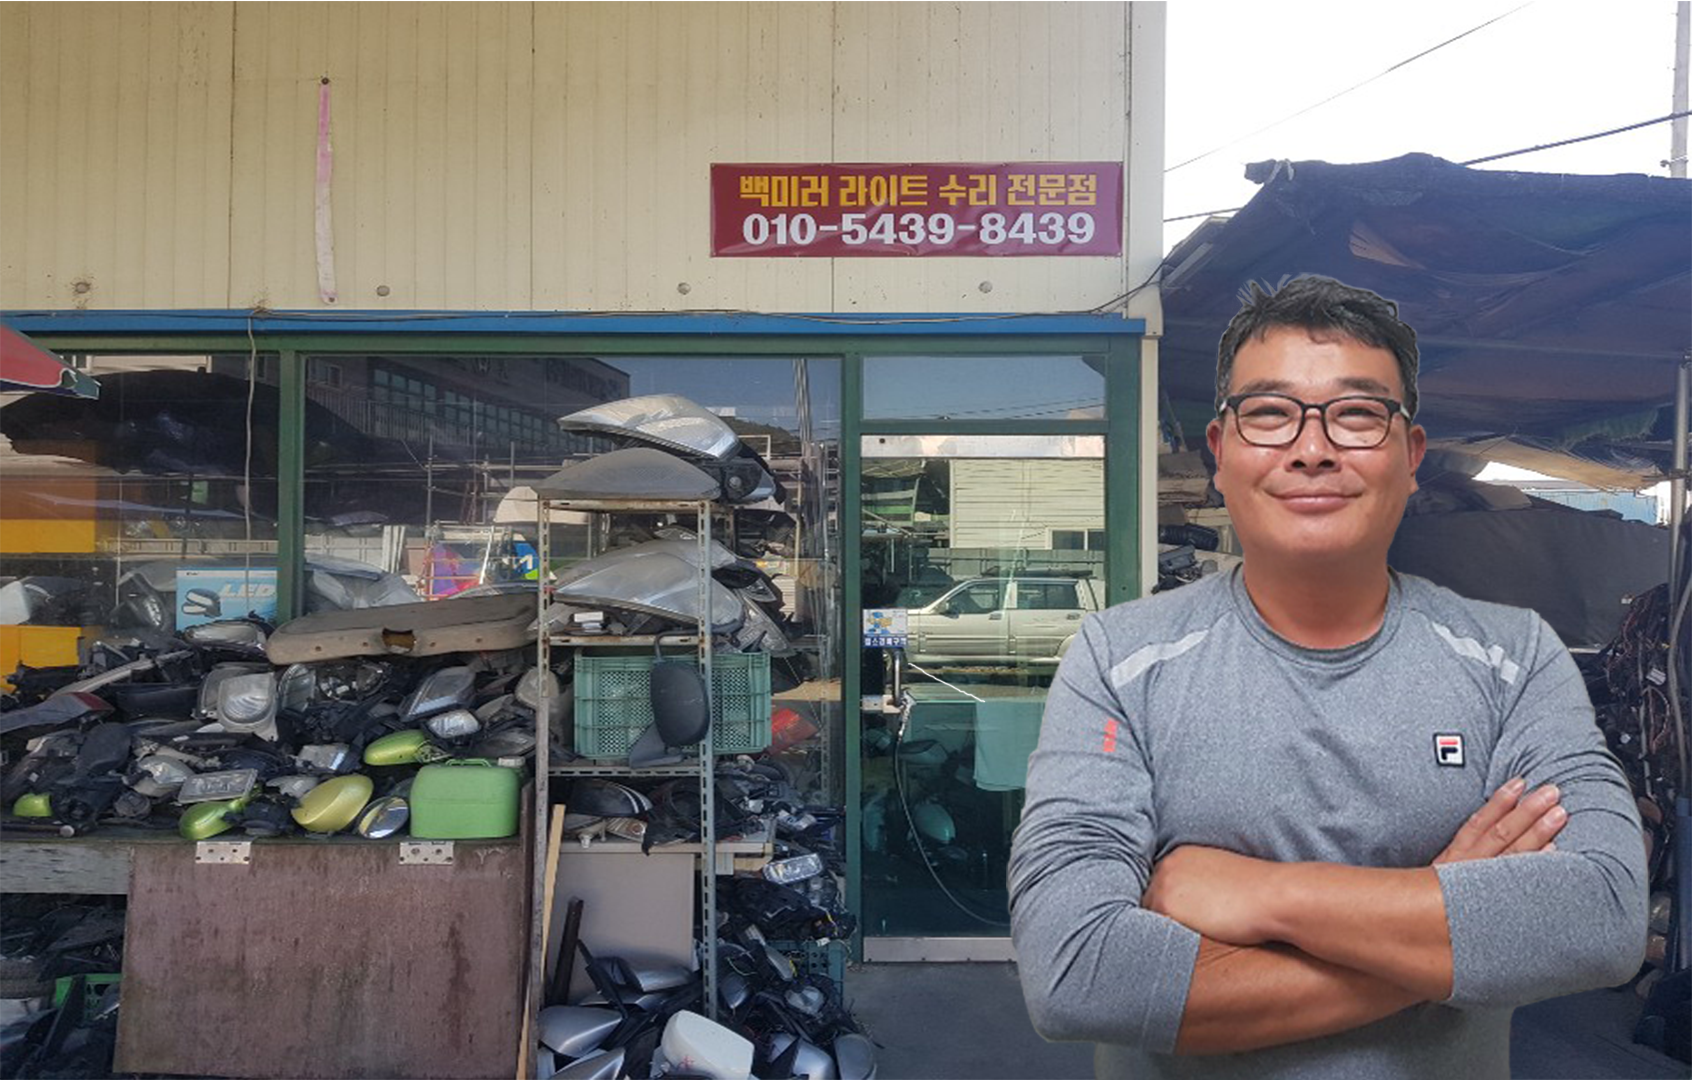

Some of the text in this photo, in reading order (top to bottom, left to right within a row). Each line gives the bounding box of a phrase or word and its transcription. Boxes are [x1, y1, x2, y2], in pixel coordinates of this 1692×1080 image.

[739, 174, 1098, 207] 백미러 라이트 수리 전문점
[742, 212, 1095, 245] 010-5439-8439
[219, 582, 275, 598] LED
